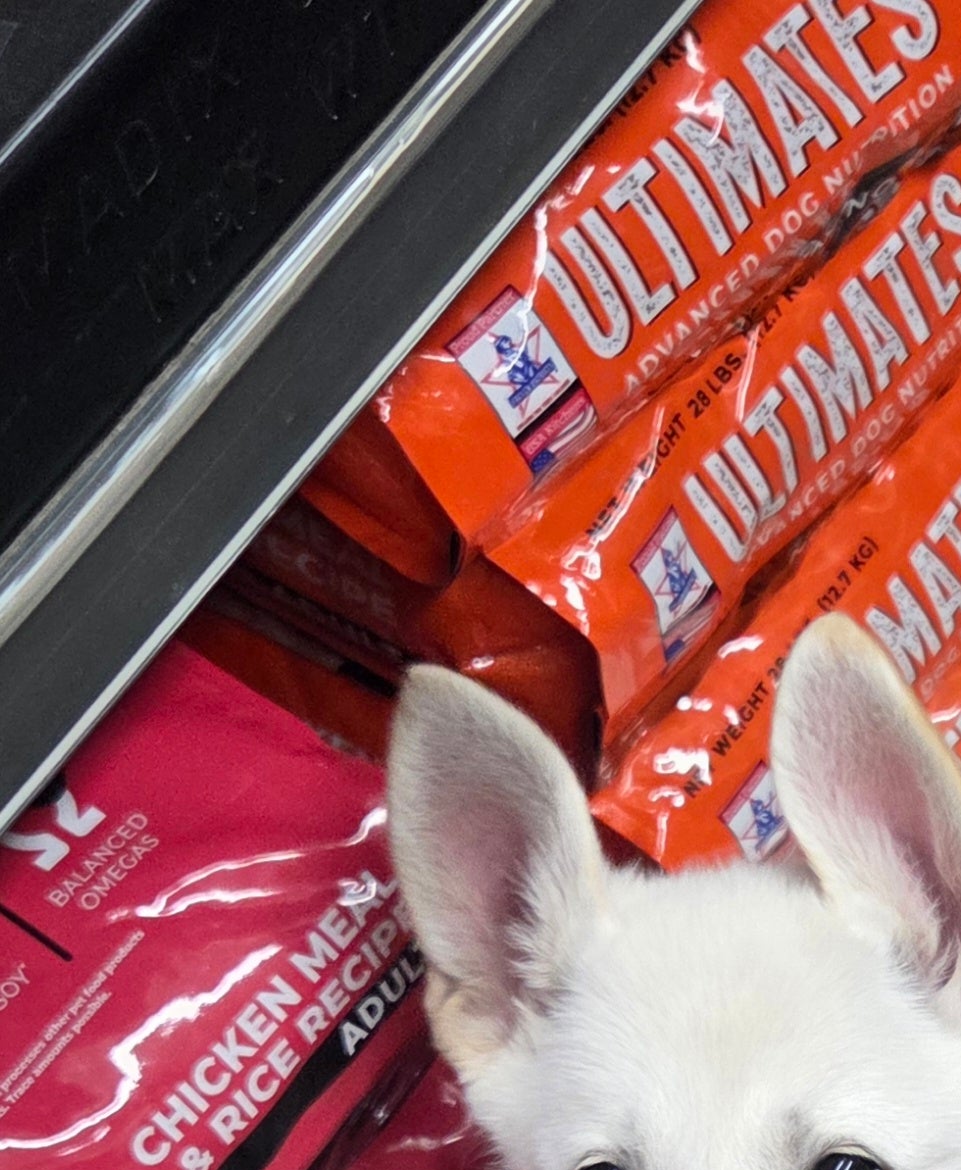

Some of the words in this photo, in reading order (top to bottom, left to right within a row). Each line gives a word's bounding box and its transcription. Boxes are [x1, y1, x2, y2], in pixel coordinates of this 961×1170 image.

[624, 251, 760, 396] ADVANCED
[762, 191, 822, 255] DOG
[687, 388, 711, 420] 28
[816, 569, 853, 613] (12.7
[848, 535, 880, 573] KG)
[47, 810, 150, 910] BALANCED
[79, 832, 161, 912] OMEGAS
[0, 1038, 48, 1093] processes
[42, 1011, 72, 1042] other
[66, 994, 88, 1016] pet
[82, 970, 108, 998] food
[103, 928, 147, 975] products
[7, 1074, 36, 1105] Trace
[31, 1030, 75, 1078] amounts
[70, 987, 114, 1035] possible.
[130, 973, 301, 1168] CHICKEN
[287, 868, 402, 988] MEAL
[335, 934, 429, 1057] ADUL
[209, 1039, 301, 1149] RICE
